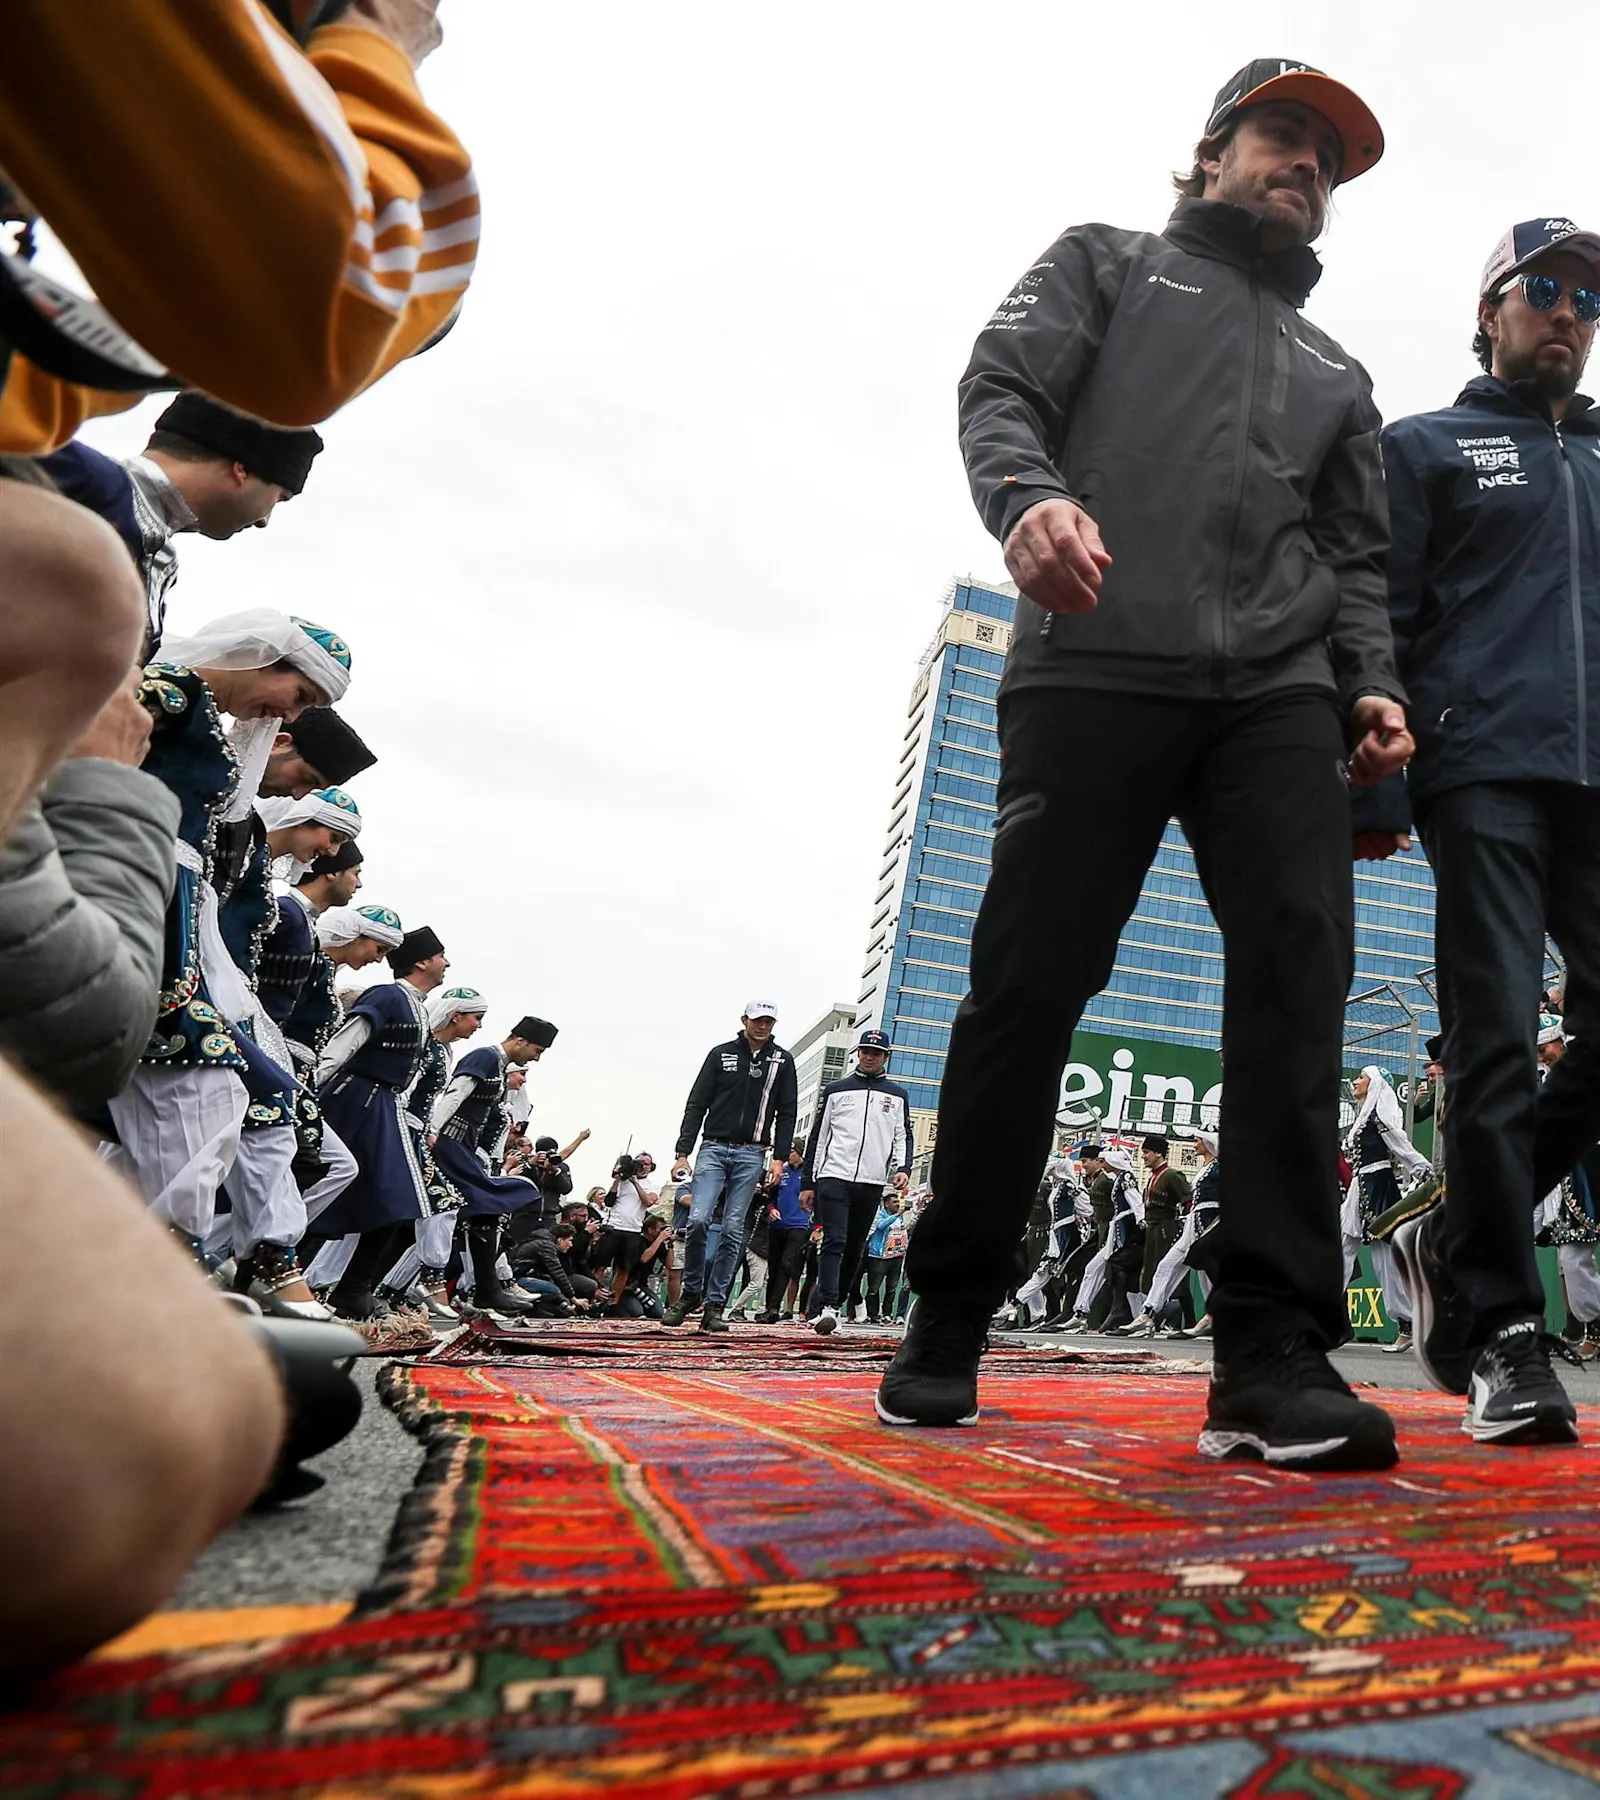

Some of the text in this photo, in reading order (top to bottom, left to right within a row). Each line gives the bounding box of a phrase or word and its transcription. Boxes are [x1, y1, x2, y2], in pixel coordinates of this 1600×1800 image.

[1456, 435, 1517, 448] KINGFISHER
[1473, 452, 1520, 467] HYPE
[1477, 472, 1529, 490] NEC
